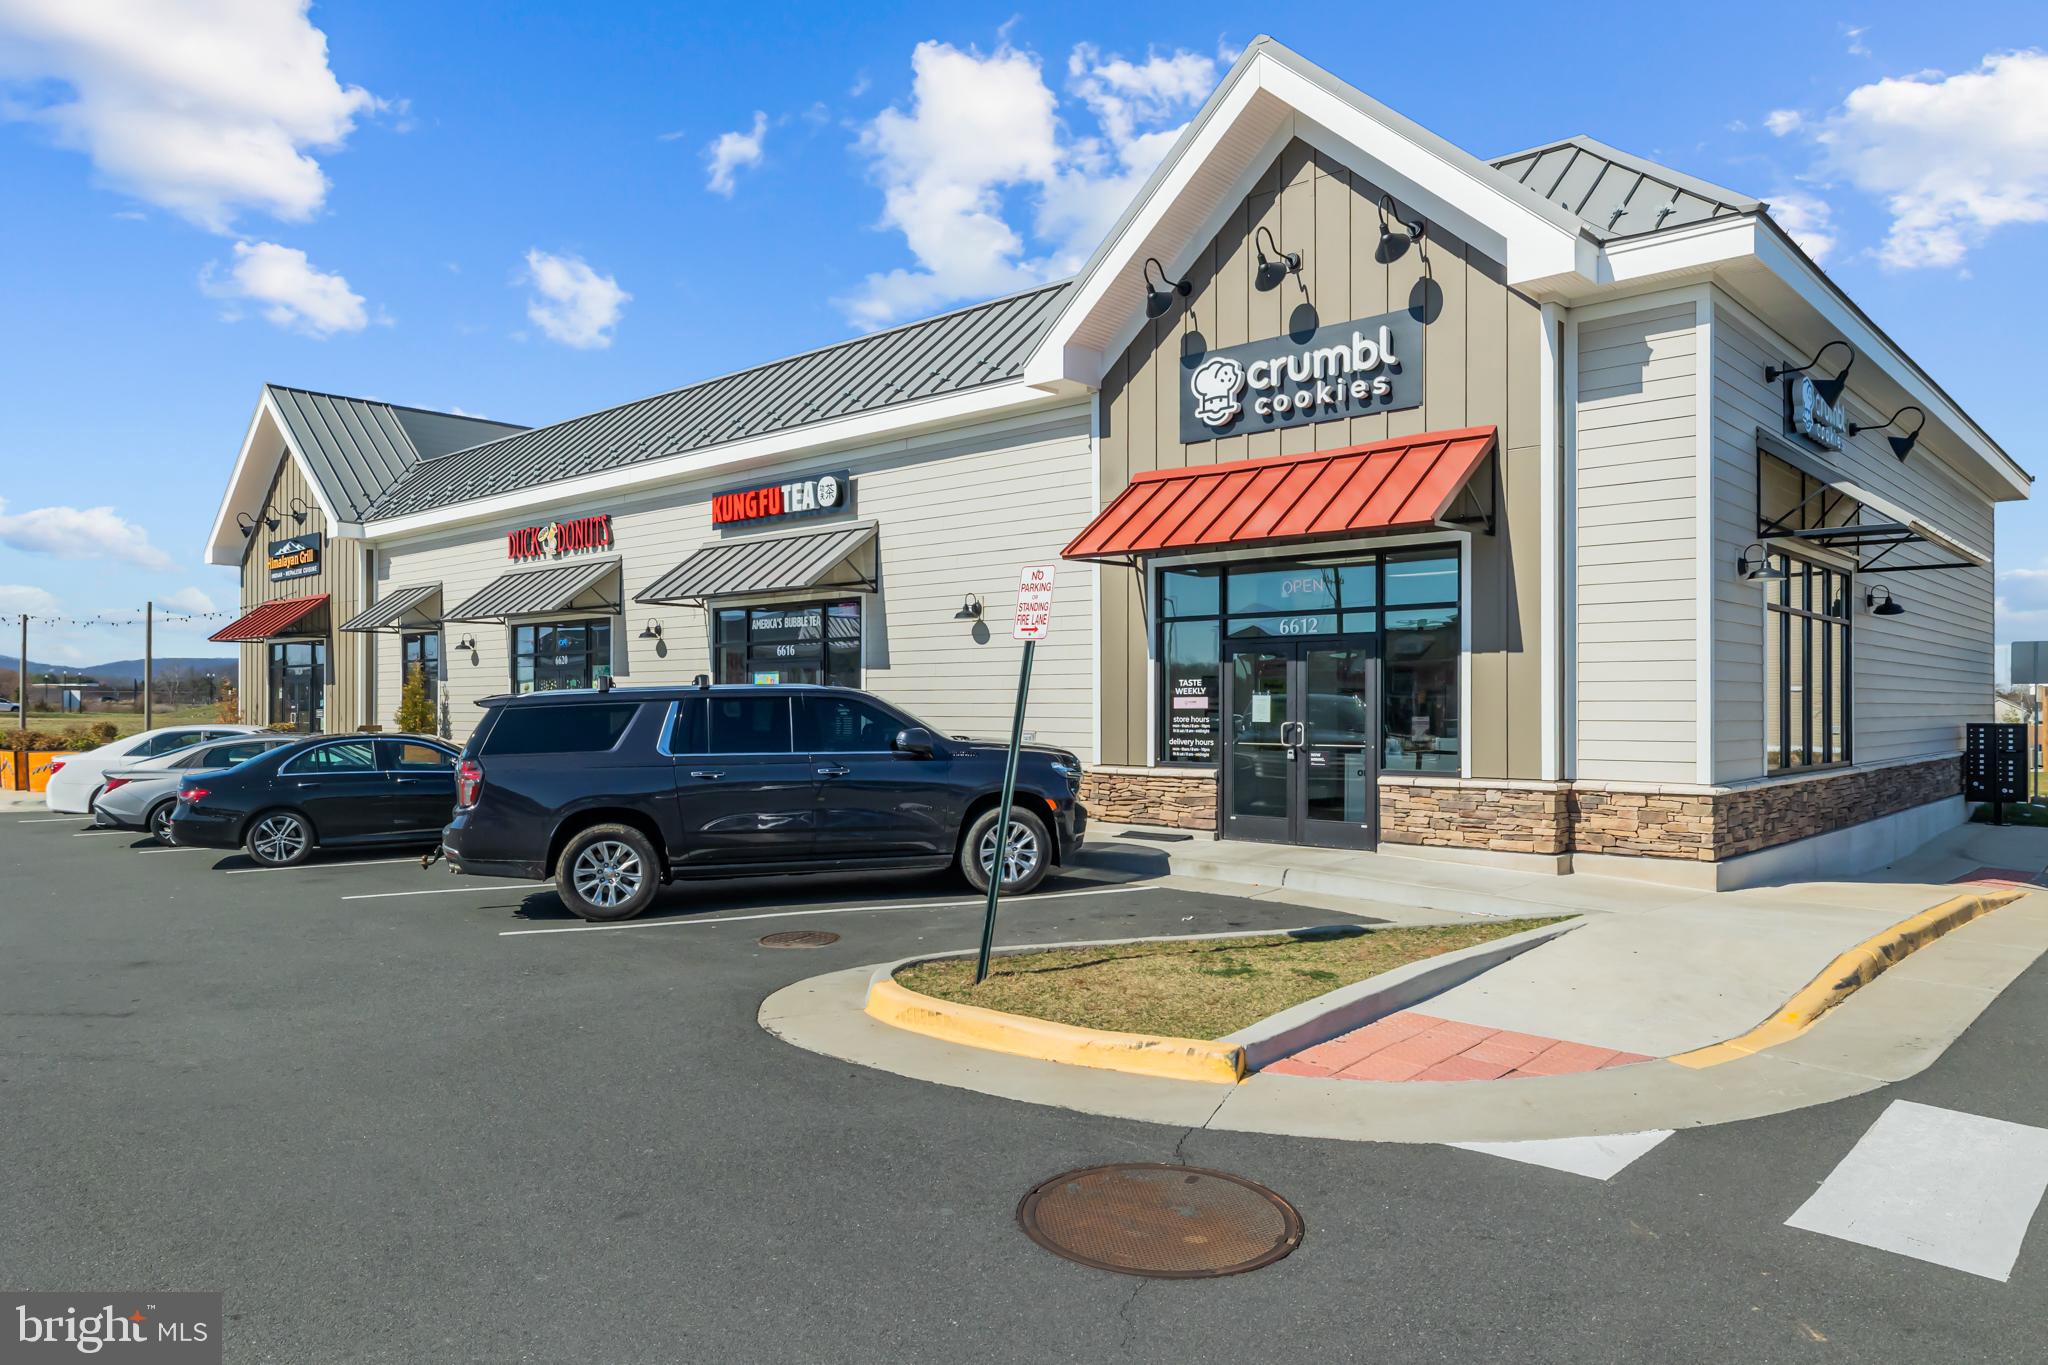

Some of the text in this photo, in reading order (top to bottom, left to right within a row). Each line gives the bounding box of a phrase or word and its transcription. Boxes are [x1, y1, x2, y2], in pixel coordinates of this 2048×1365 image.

[1247, 325, 1400, 389] crumbl
[1255, 376, 1391, 415] cookies
[781, 481, 818, 513] TEA
[507, 514, 610, 560] DUCK DONUTS
[266, 549, 314, 570] Himalayan Grill
[1031, 570, 1044, 581] NO
[1020, 582, 1052, 593] PARKING
[1282, 578, 1324, 595] OPEN
[1018, 602, 1049, 612] STANDING
[752, 615, 821, 630] AMERICA'S BUBBLE TEA
[1016, 613, 1048, 626] FIRE LANE
[1279, 617, 1318, 635] 6612
[776, 644, 795, 657] 6616
[555, 655, 568, 666] 6620
[1178, 679, 1202, 687] TASTE
[1175, 687, 1207, 695] WEEKLY
[1190, 715, 1210, 723] hours
[1168, 737, 1214, 747] delivery hours
